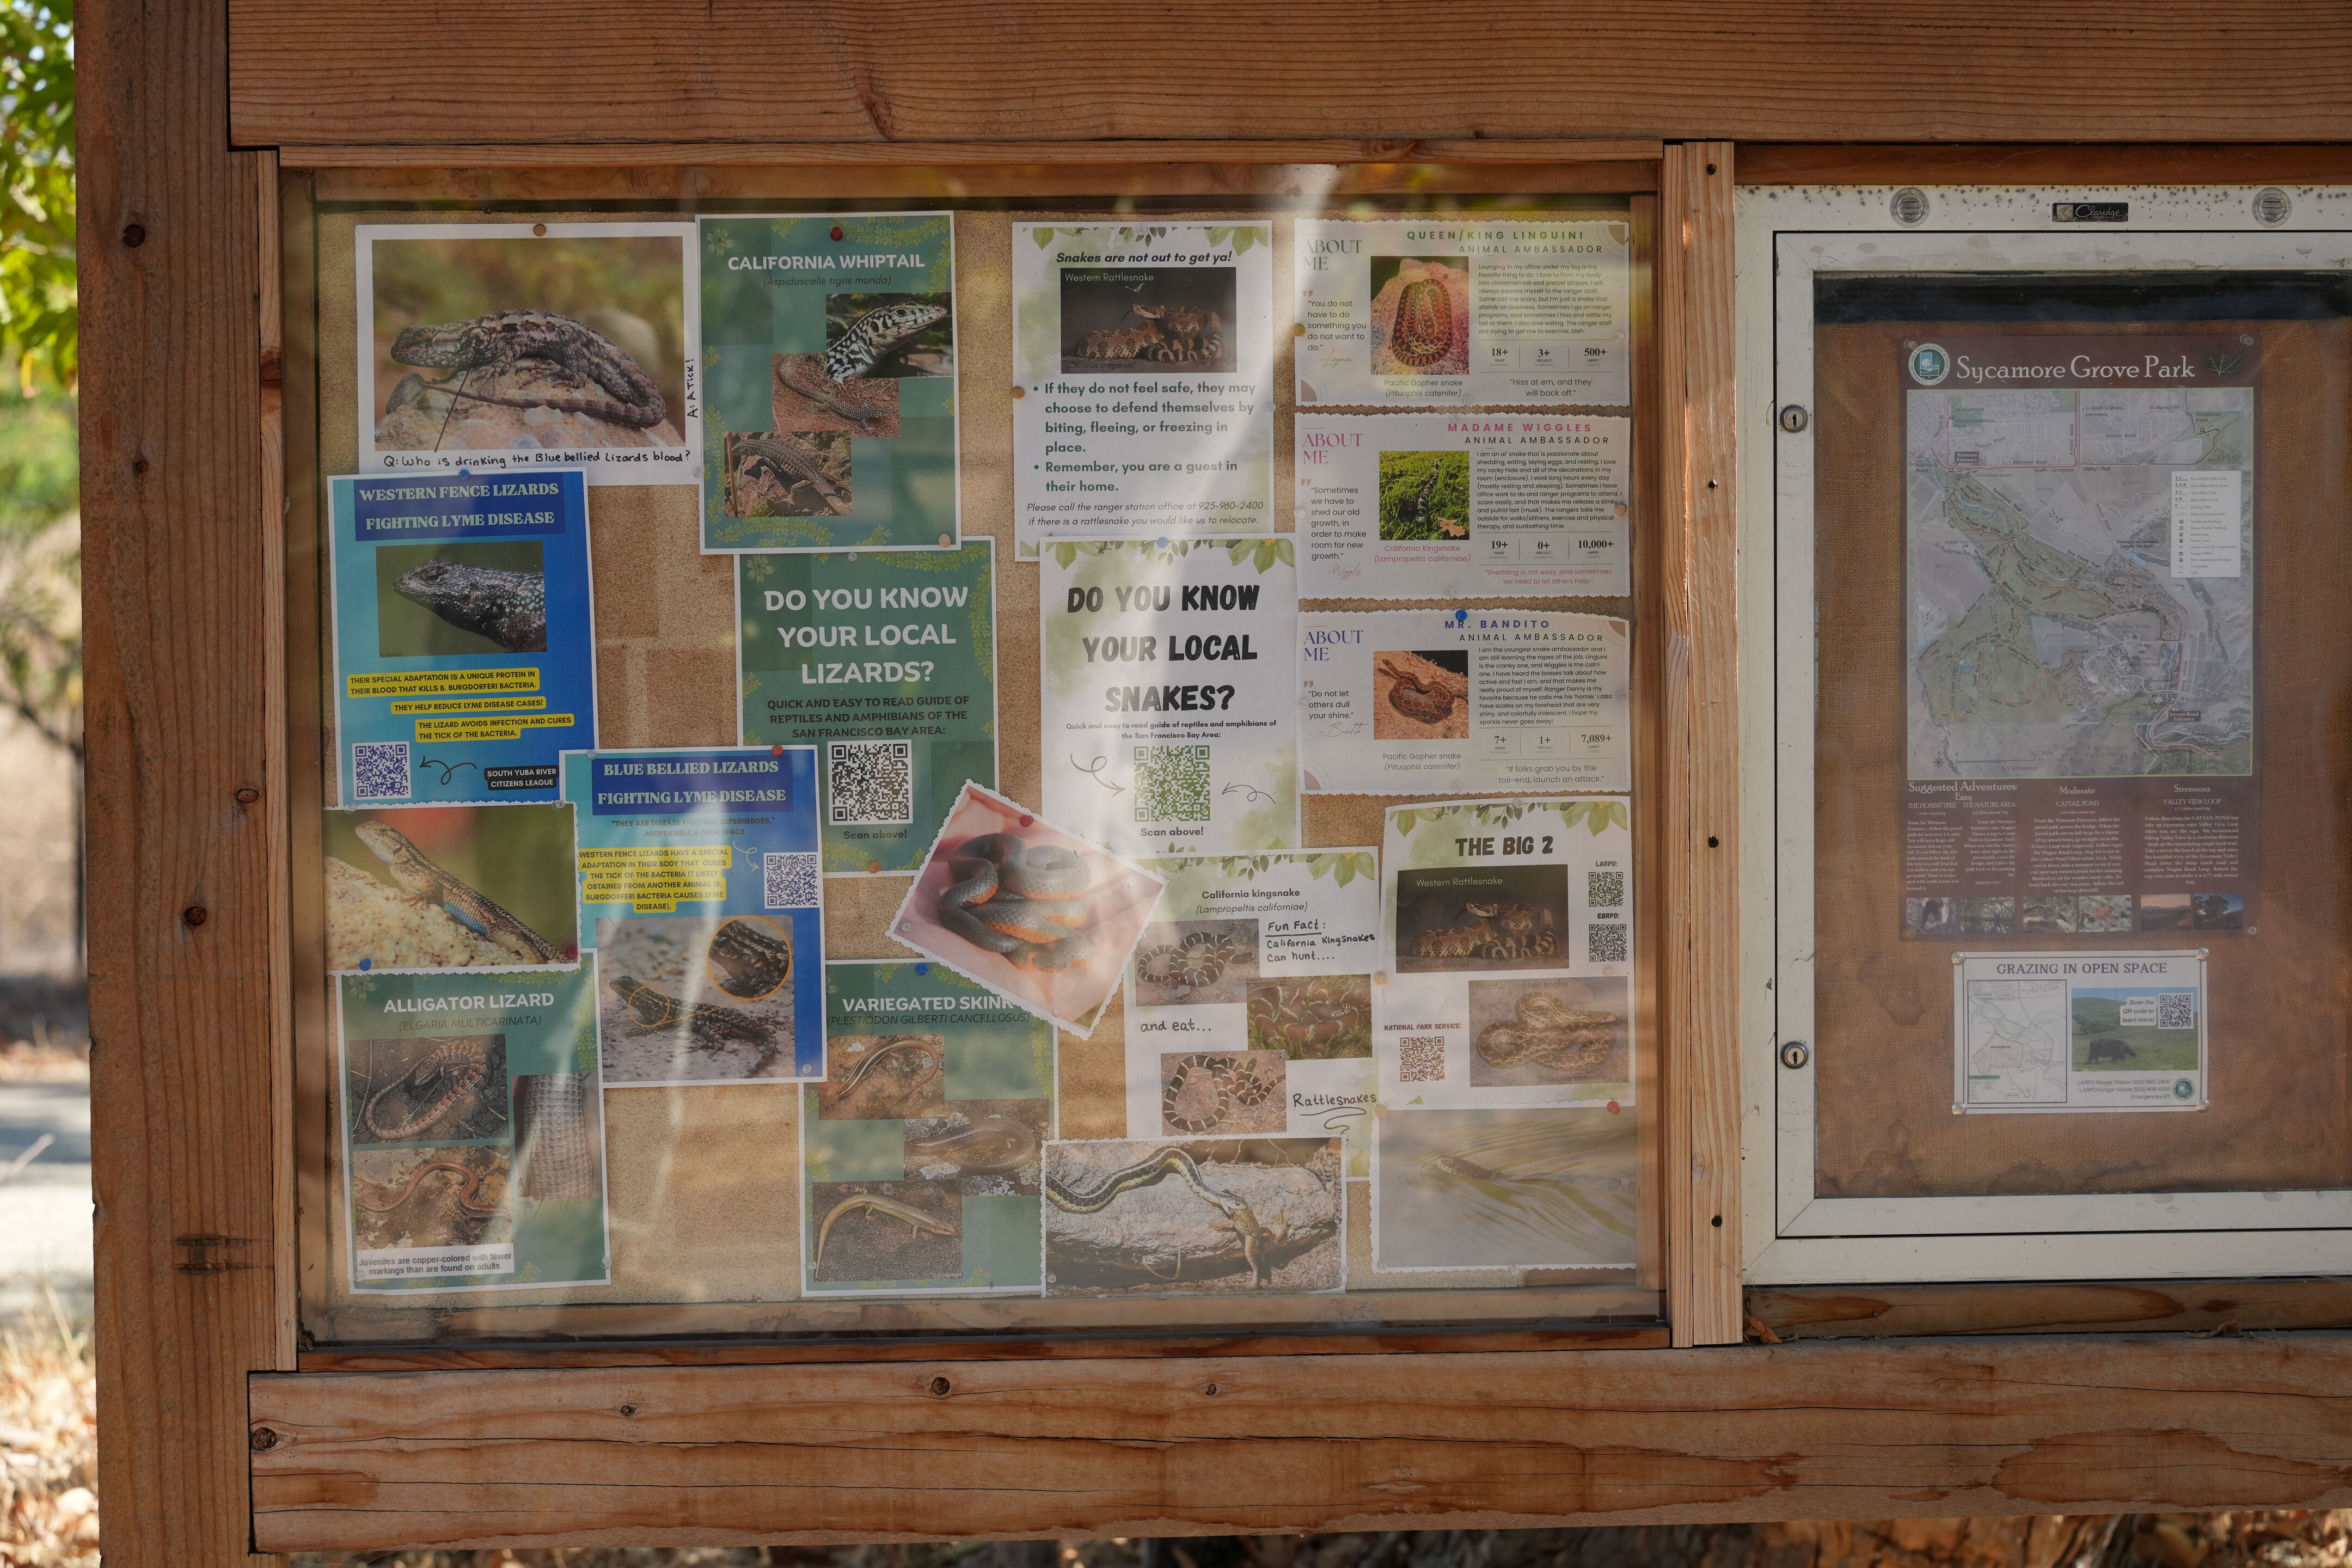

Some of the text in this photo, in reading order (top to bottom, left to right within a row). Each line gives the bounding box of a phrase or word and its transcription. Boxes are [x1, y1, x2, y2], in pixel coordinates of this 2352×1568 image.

[2075, 204, 2124, 218] Claridge
[1407, 229, 1582, 241] QUEEN/KING LINGUINI
[1302, 240, 1362, 253] ABOUT
[728, 254, 925, 270] CALIFORNIA WHIPTAIL
[1056, 252, 1101, 262] Snakes
[1128, 253, 1148, 262] not
[1152, 253, 1171, 262] out
[1174, 253, 1186, 262] to
[1189, 253, 1210, 265] get
[1212, 251, 1232, 265] ya!
[1303, 257, 1328, 270] ME
[764, 274, 891, 288] (Aspidoscelis tigris munda)
[1065, 272, 1154, 281] Western Rattlesnake
[1957, 355, 2195, 383] Sycamore Grove Park
[1045, 381, 1255, 397] If they do not feel safe, they may
[1448, 424, 1590, 432] MADAME WIGGLES
[1302, 433, 1363, 447] ABOUT
[438, 458, 450, 467] is
[512, 455, 529, 463] the
[536, 453, 561, 462] Blue
[564, 451, 600, 462] bellied
[653, 450, 690, 462] blood?
[1303, 450, 1328, 464] ME
[359, 483, 559, 501] WESTERN FENCE LIZARDS
[1027, 503, 1056, 511] Please
[1059, 503, 1075, 511] call
[1077, 503, 1091, 511] the
[1158, 501, 1184, 510] office
[1199, 501, 1263, 510] 925-960-2400
[366, 512, 554, 530] FIGHTING LYME DISEASE
[1491, 539, 1614, 550] 19+ 0+ 10,000+
[764, 586, 970, 611] DO YOU KNOW
[1067, 585, 1260, 613] DO YOU KNOW
[1445, 620, 1549, 629] MR. BANDITO
[777, 624, 956, 647] YOUR LOCAL
[1304, 630, 1363, 645] ABOUT
[1082, 634, 1257, 663] YOUR LOCAL
[1304, 647, 1329, 661] ME
[802, 661, 934, 684] LIZARDS?
[1105, 685, 1235, 712] SNAKES?
[604, 761, 779, 776] BLUE BELLIED LIZARDS
[1909, 781, 2018, 793] Suggested Adventures:
[2060, 786, 2095, 794] Moderate
[2174, 784, 2210, 792] Strenuous
[598, 789, 786, 805] FIGHTING LYME DISEASE
[1955, 792, 1972, 802] Easy
[843, 829, 907, 839] Scan above!
[1455, 836, 1553, 856] THE BIG 2
[1202, 888, 1300, 899] California kingsnake
[1268, 922, 1289, 932] Fun
[1267, 939, 1316, 949] California
[1996, 963, 2167, 974] GRAZING IN OPEN SPACE
[384, 993, 554, 1013] ALLIGATOR LIZARD
[842, 996, 1014, 1012] VARIEGATED SKINK
[399, 1015, 541, 1032] (ELGARIA MULTICARINATA)
[827, 1011, 1031, 1026] (PLESTIODON GILBERTI CANCELLOSUS)
[1141, 1018, 1211, 1032] and eat...
[1293, 1093, 1378, 1108] Rattlesnakes
[413, 1254, 470, 1264] copper-colored
